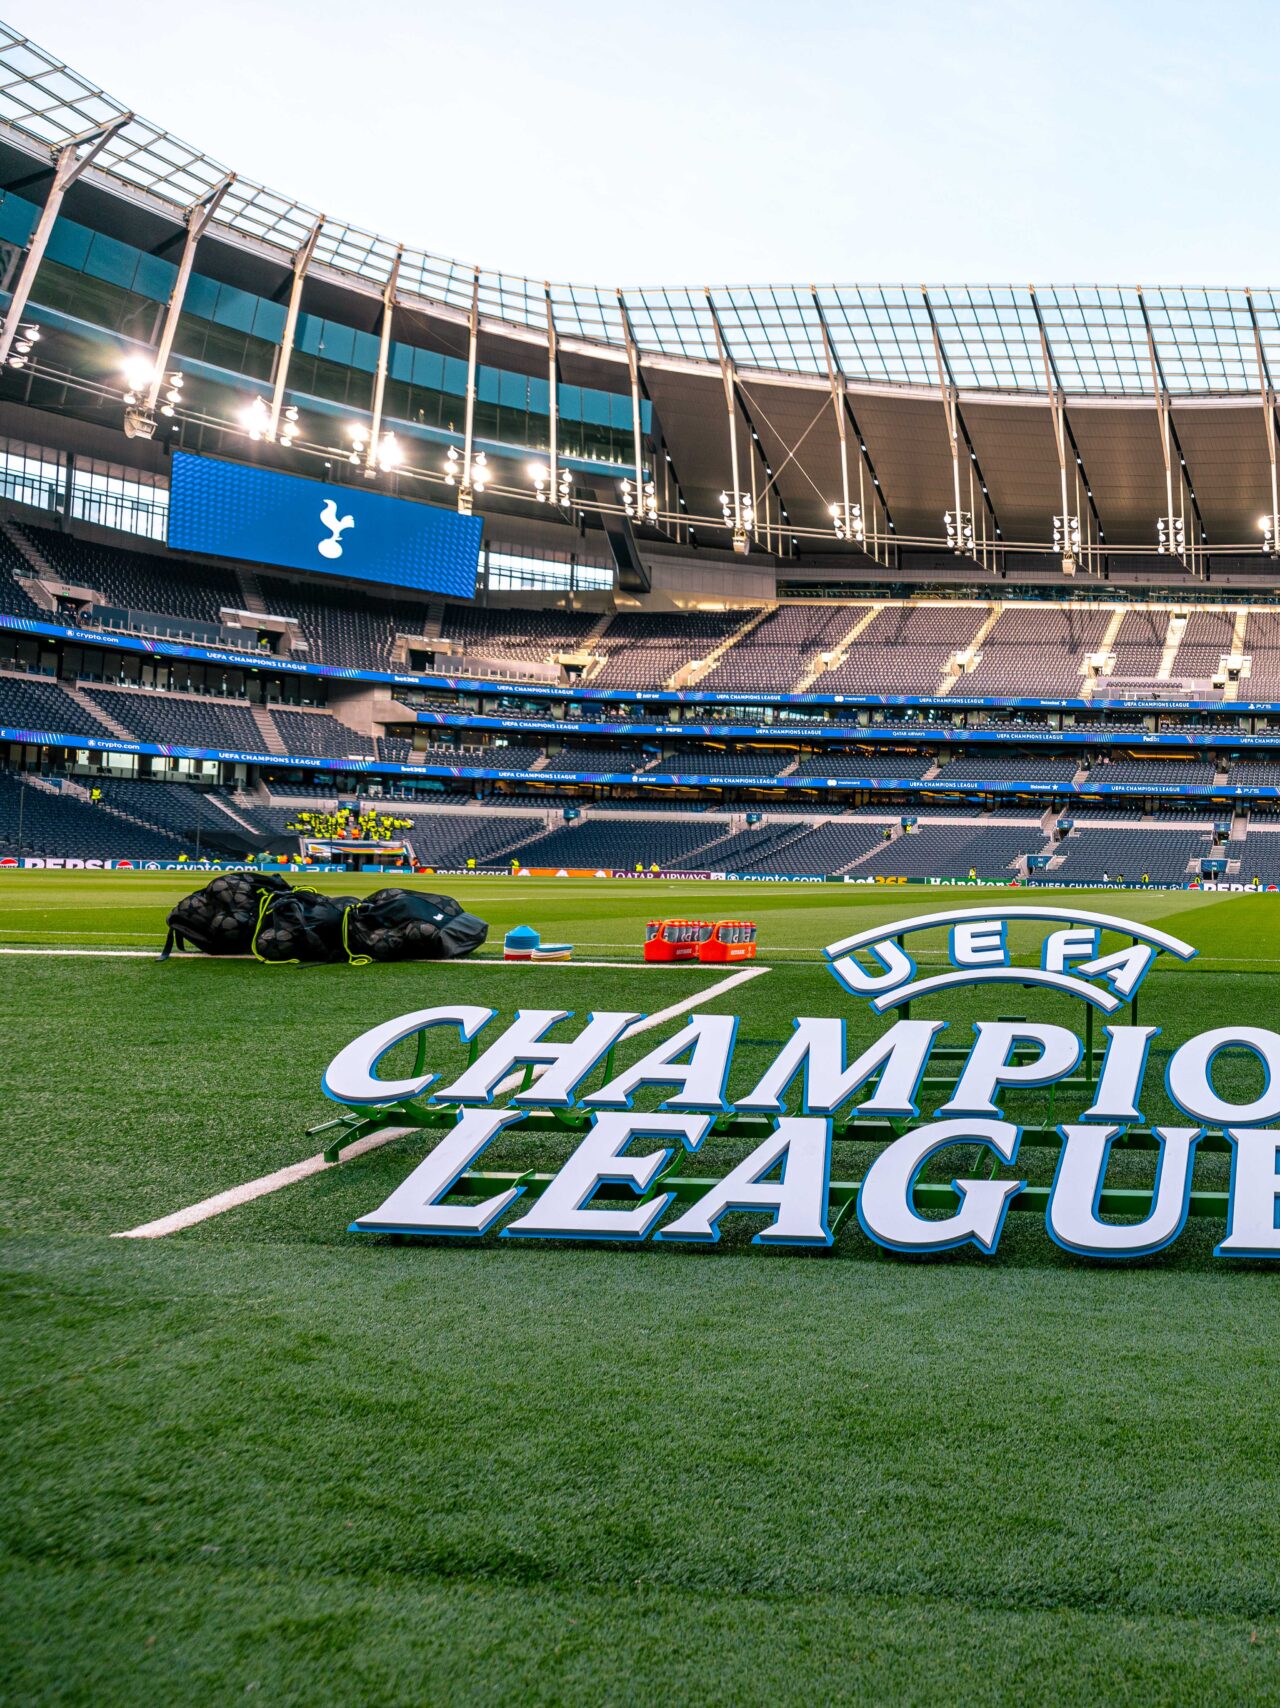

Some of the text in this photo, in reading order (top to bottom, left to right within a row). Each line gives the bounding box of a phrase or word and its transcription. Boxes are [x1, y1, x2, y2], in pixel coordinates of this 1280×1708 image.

[76, 632, 120, 644] crypto.com
[206, 652, 308, 671] UEFA CHAMPIONS LEAGUE
[97, 741, 140, 750] crypto.com
[240, 754, 290, 764] CHAMPIONS
[290, 758, 321, 766] LEAGUE
[24, 858, 112, 870] PEPSI
[844, 875, 908, 884] bet365
[930, 878, 1008, 886] Heineken
[1204, 883, 1263, 892] PEPSI
[826, 921, 1157, 999] UEFA
